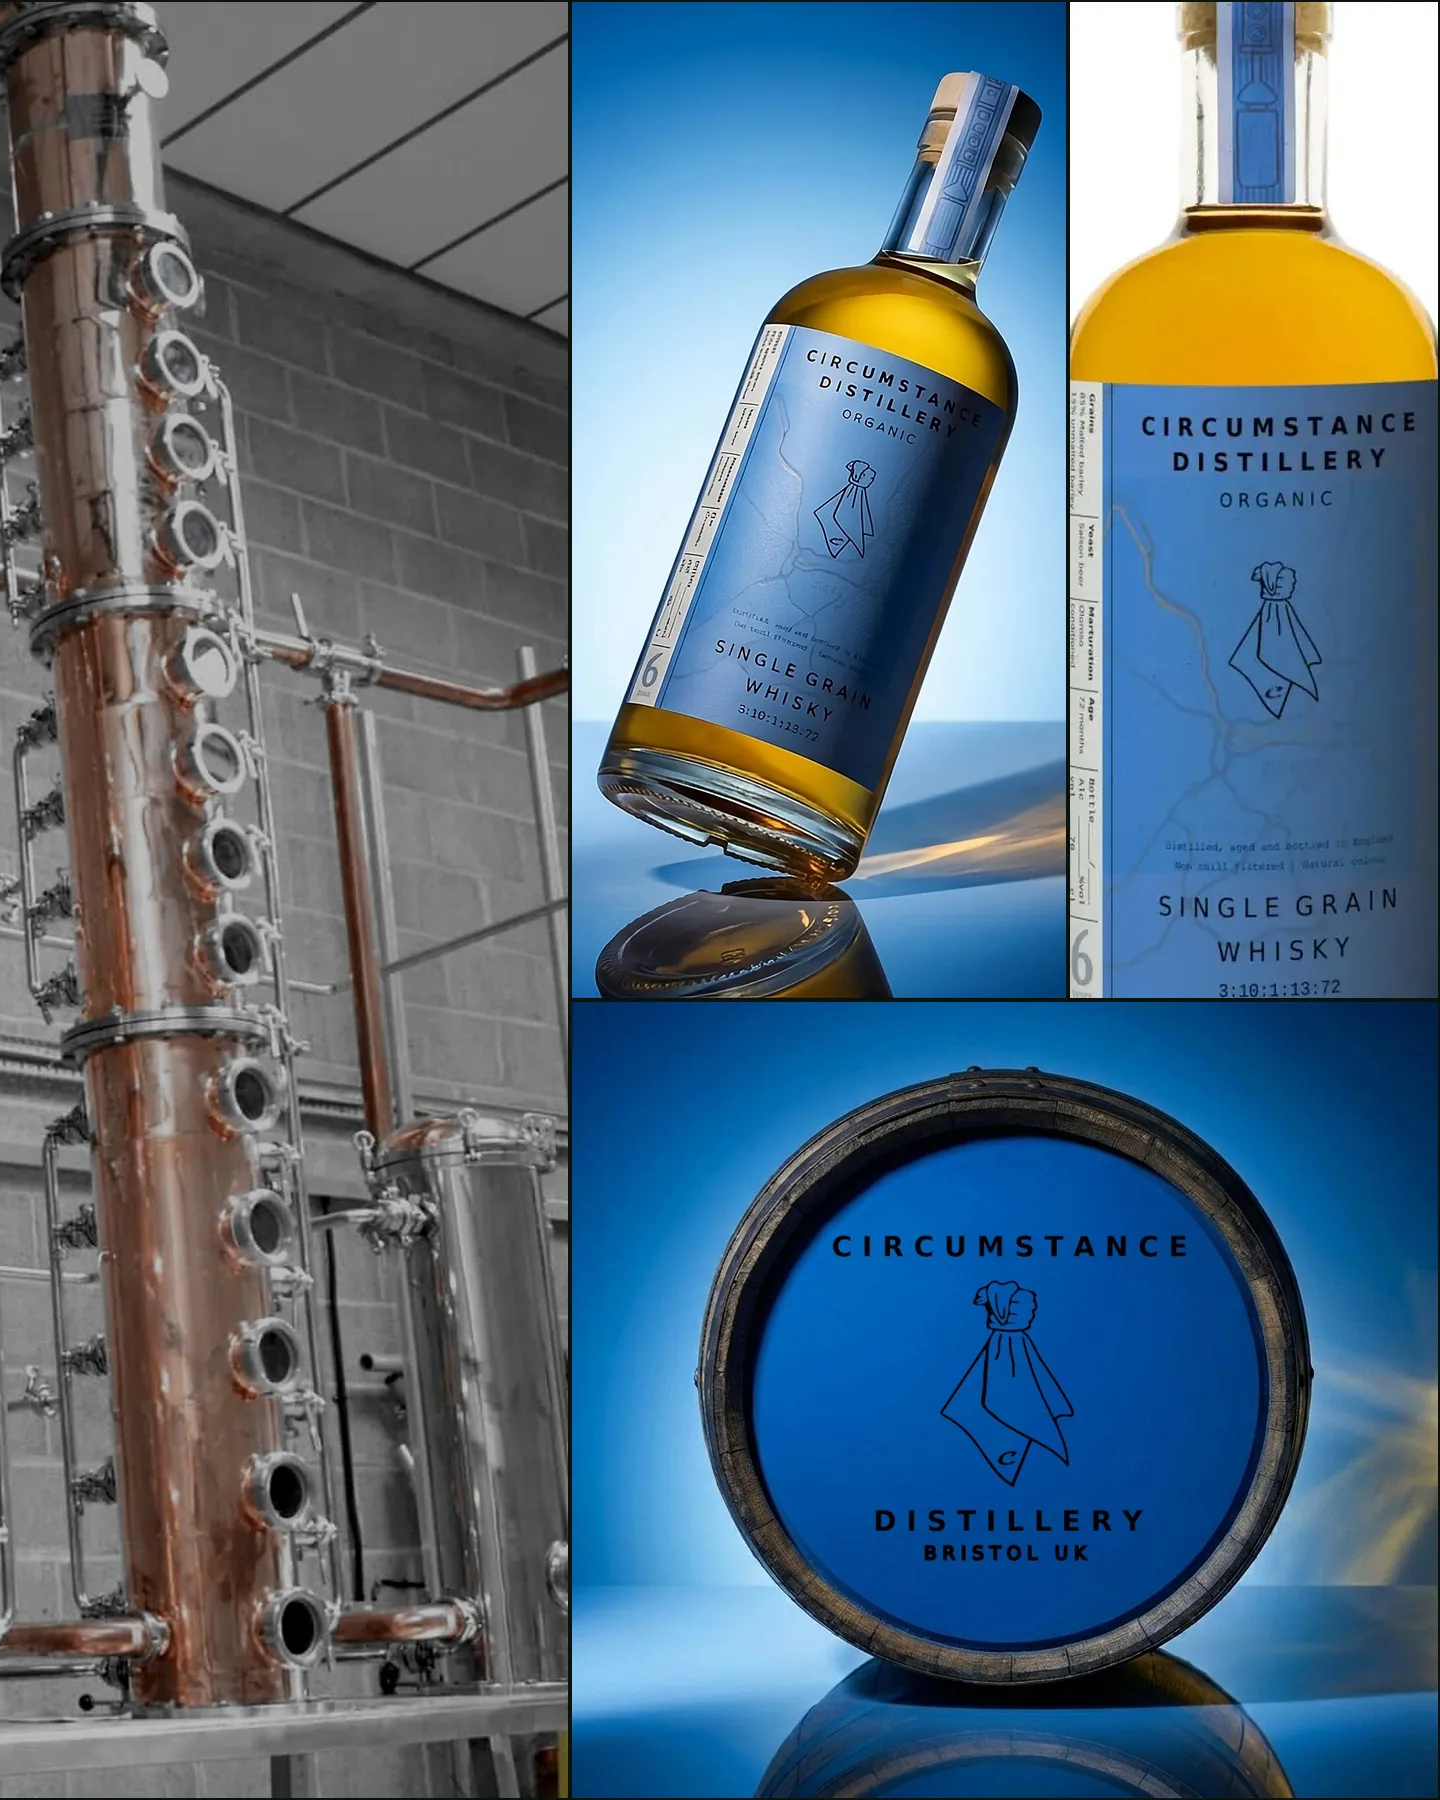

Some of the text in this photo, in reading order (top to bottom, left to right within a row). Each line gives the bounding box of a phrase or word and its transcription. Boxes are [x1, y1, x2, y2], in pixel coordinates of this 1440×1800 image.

[806, 349, 981, 428] CIRCUMSTANCE
[819, 375, 958, 439] DISTILLERY
[1088, 393, 1096, 434] Grains
[842, 409, 917, 445] ORGANIC
[1141, 412, 1416, 437] CIRCUMSTANCE
[1173, 448, 1386, 472] DISTILLERY
[1077, 461, 1085, 496] barley
[1219, 491, 1333, 508] ORGANIC
[1087, 524, 1095, 558] Yeast
[641, 652, 664, 688] 6
[714, 639, 797, 679] SINGLE
[805, 671, 872, 711] GRAIN
[745, 677, 833, 723] WHISKY
[1159, 887, 1397, 918] SINGLE GRAIN
[1071, 928, 1094, 987] 6
[1217, 936, 1350, 963] WHISKY
[1219, 979, 1341, 998] 3:10:1:13:72
[832, 1235, 1187, 1258] CIRCUMSTANCE
[875, 1509, 1144, 1532] DISTILLERY
[924, 1544, 1089, 1561] BRISTOL UK
